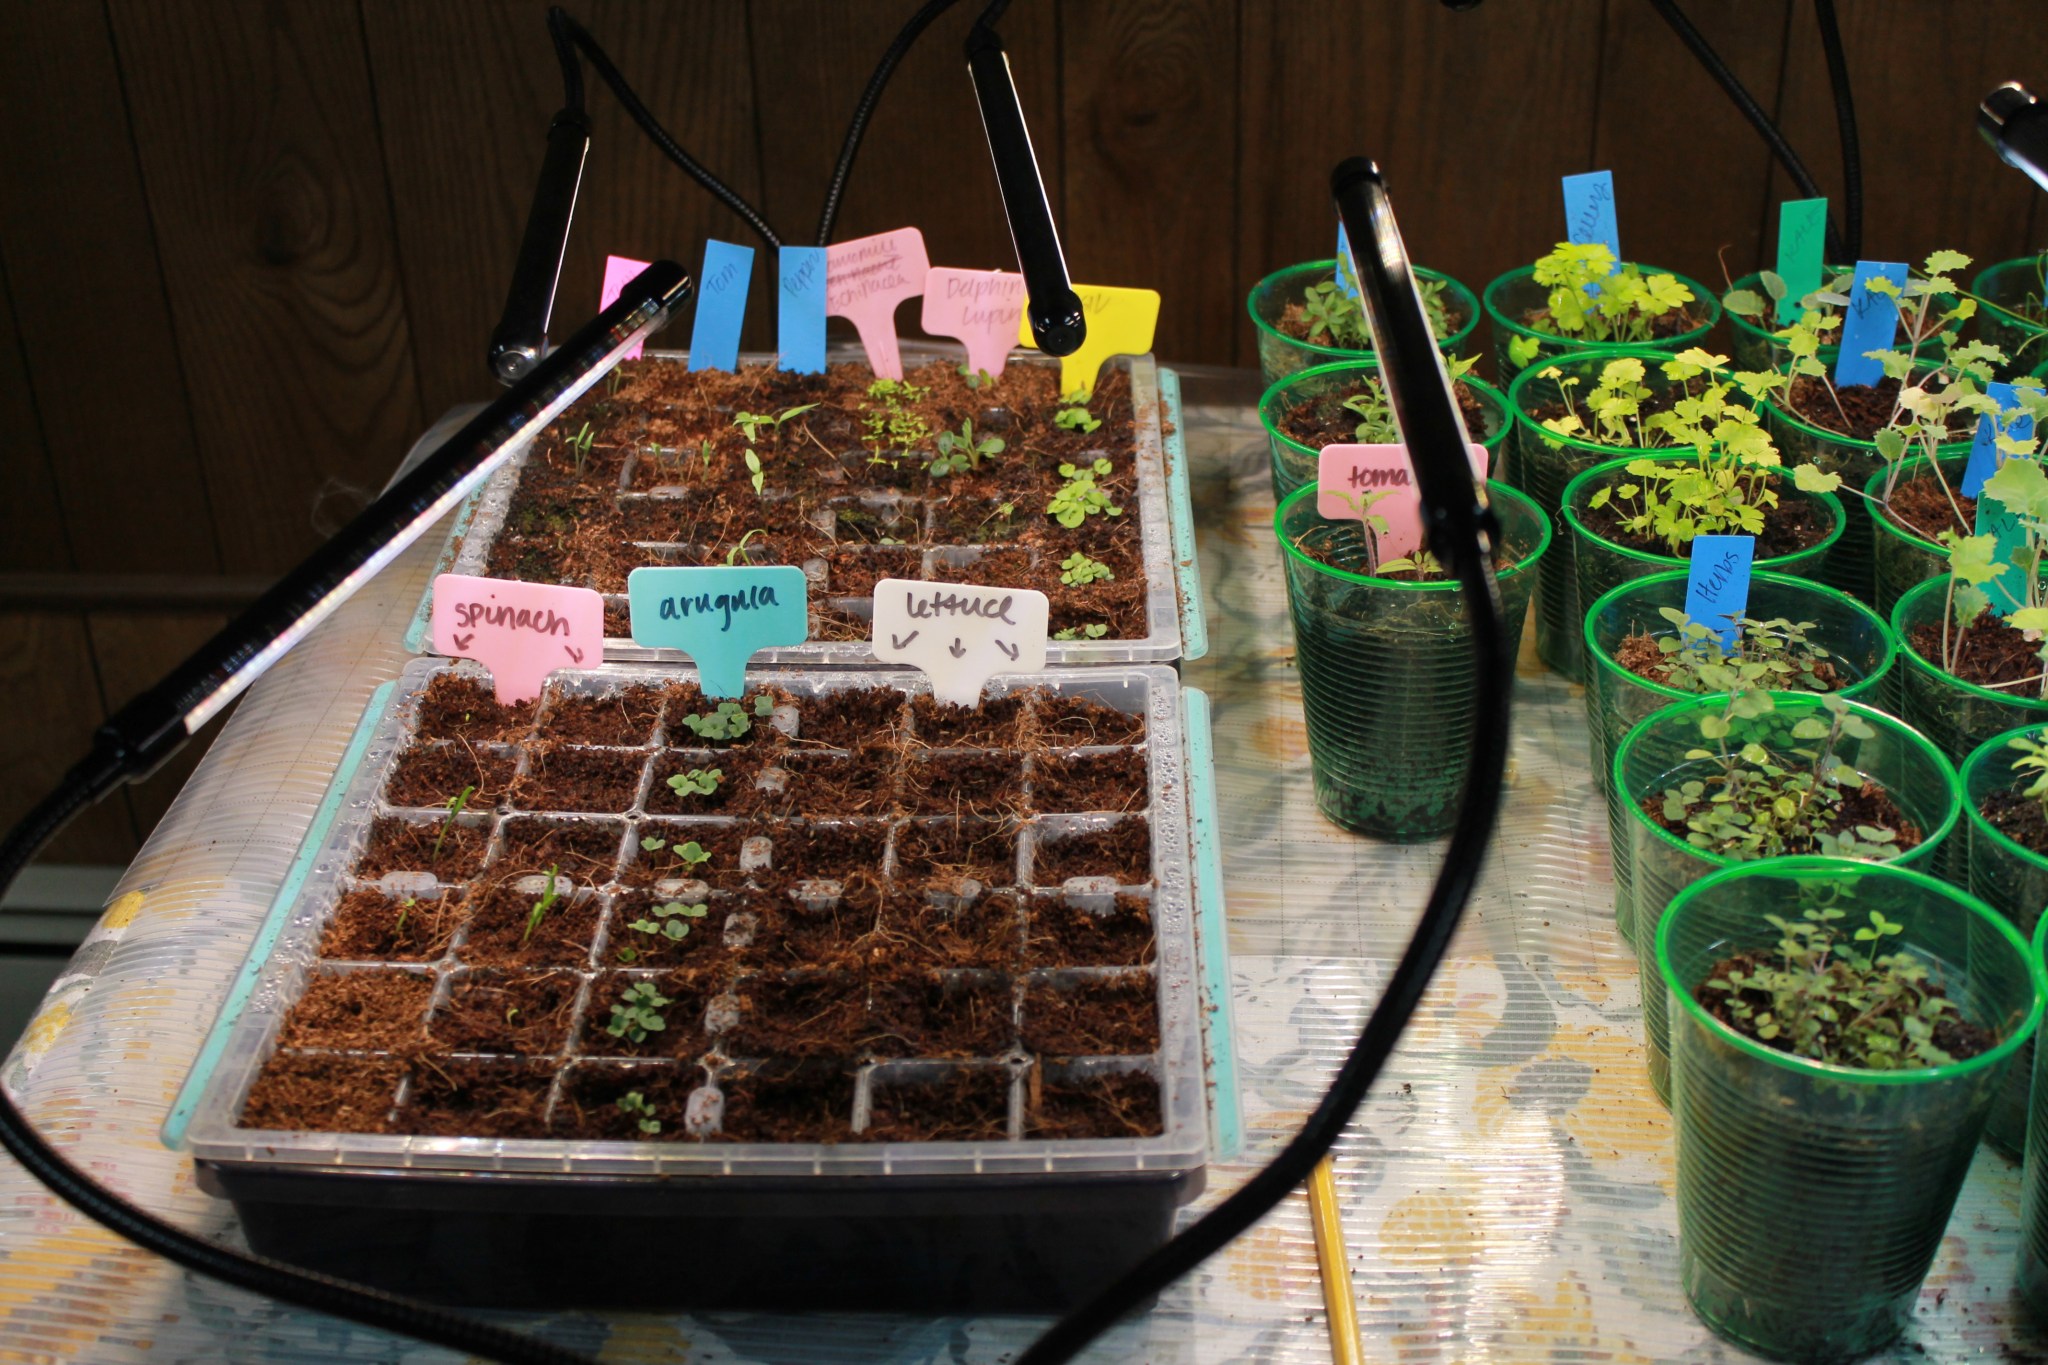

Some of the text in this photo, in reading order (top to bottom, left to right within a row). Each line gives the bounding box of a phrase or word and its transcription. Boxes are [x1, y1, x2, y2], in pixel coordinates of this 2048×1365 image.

[454, 594, 571, 637] spinach
[659, 585, 780, 633] arugula
[906, 591, 1017, 626] lettuce
